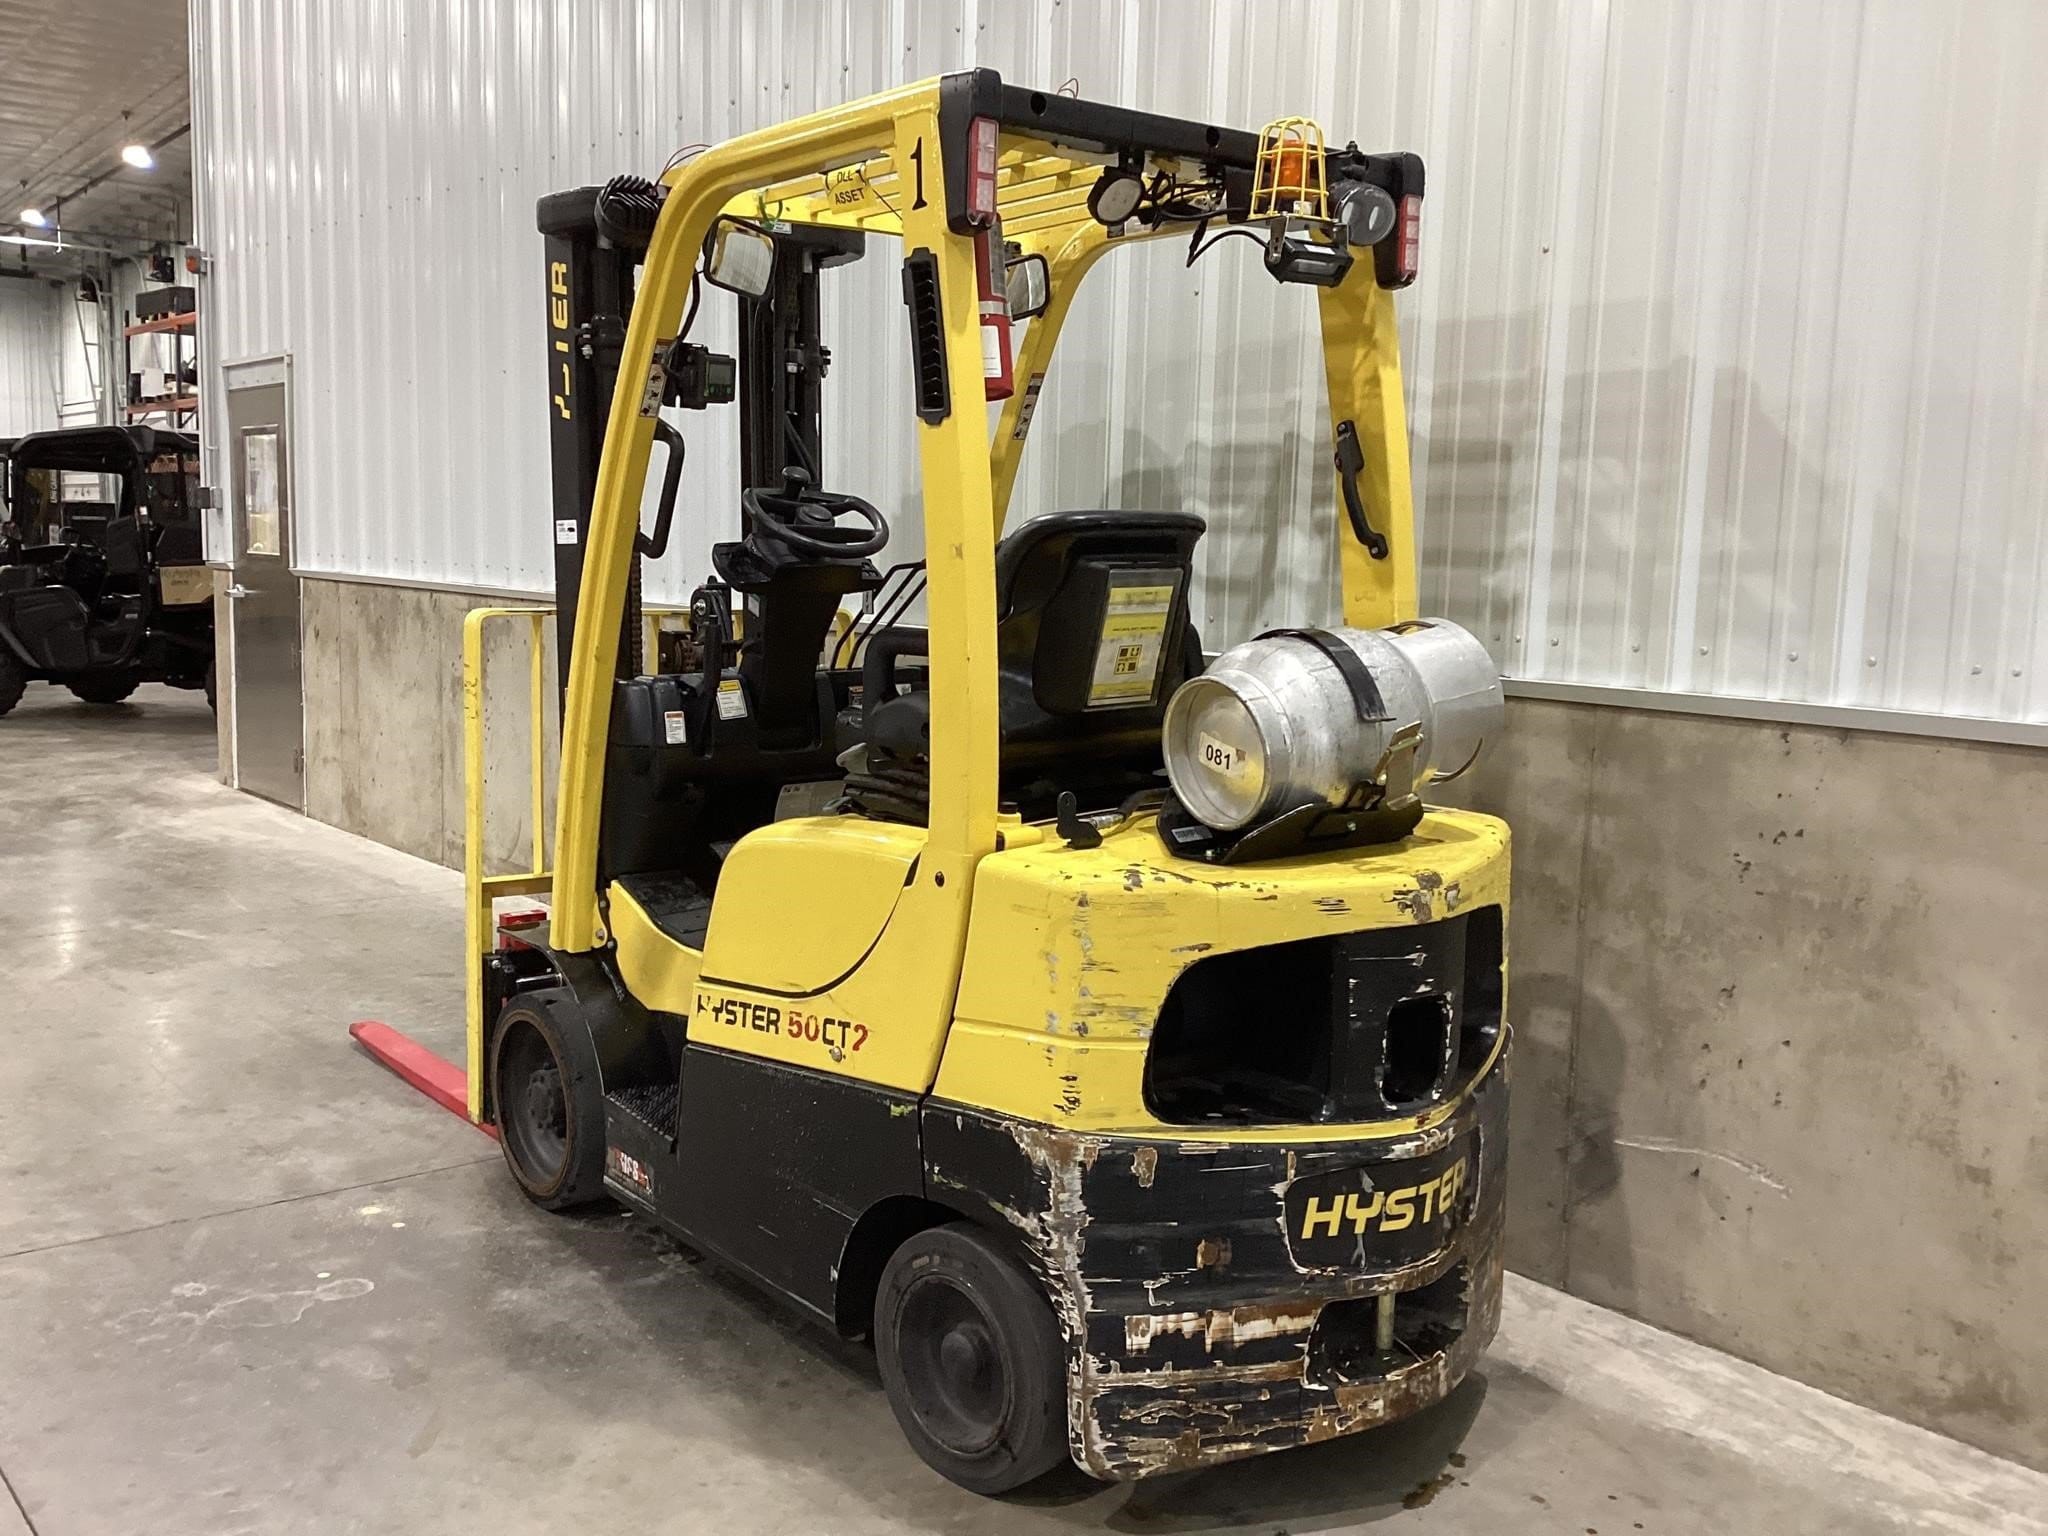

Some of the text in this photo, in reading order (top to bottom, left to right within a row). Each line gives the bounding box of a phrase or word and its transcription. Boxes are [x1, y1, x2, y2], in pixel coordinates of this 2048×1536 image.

[835, 187, 865, 205] ASSET
[910, 136, 928, 211] 1
[1206, 744, 1231, 770] 081
[1301, 1156, 1467, 1239] HYSTER
